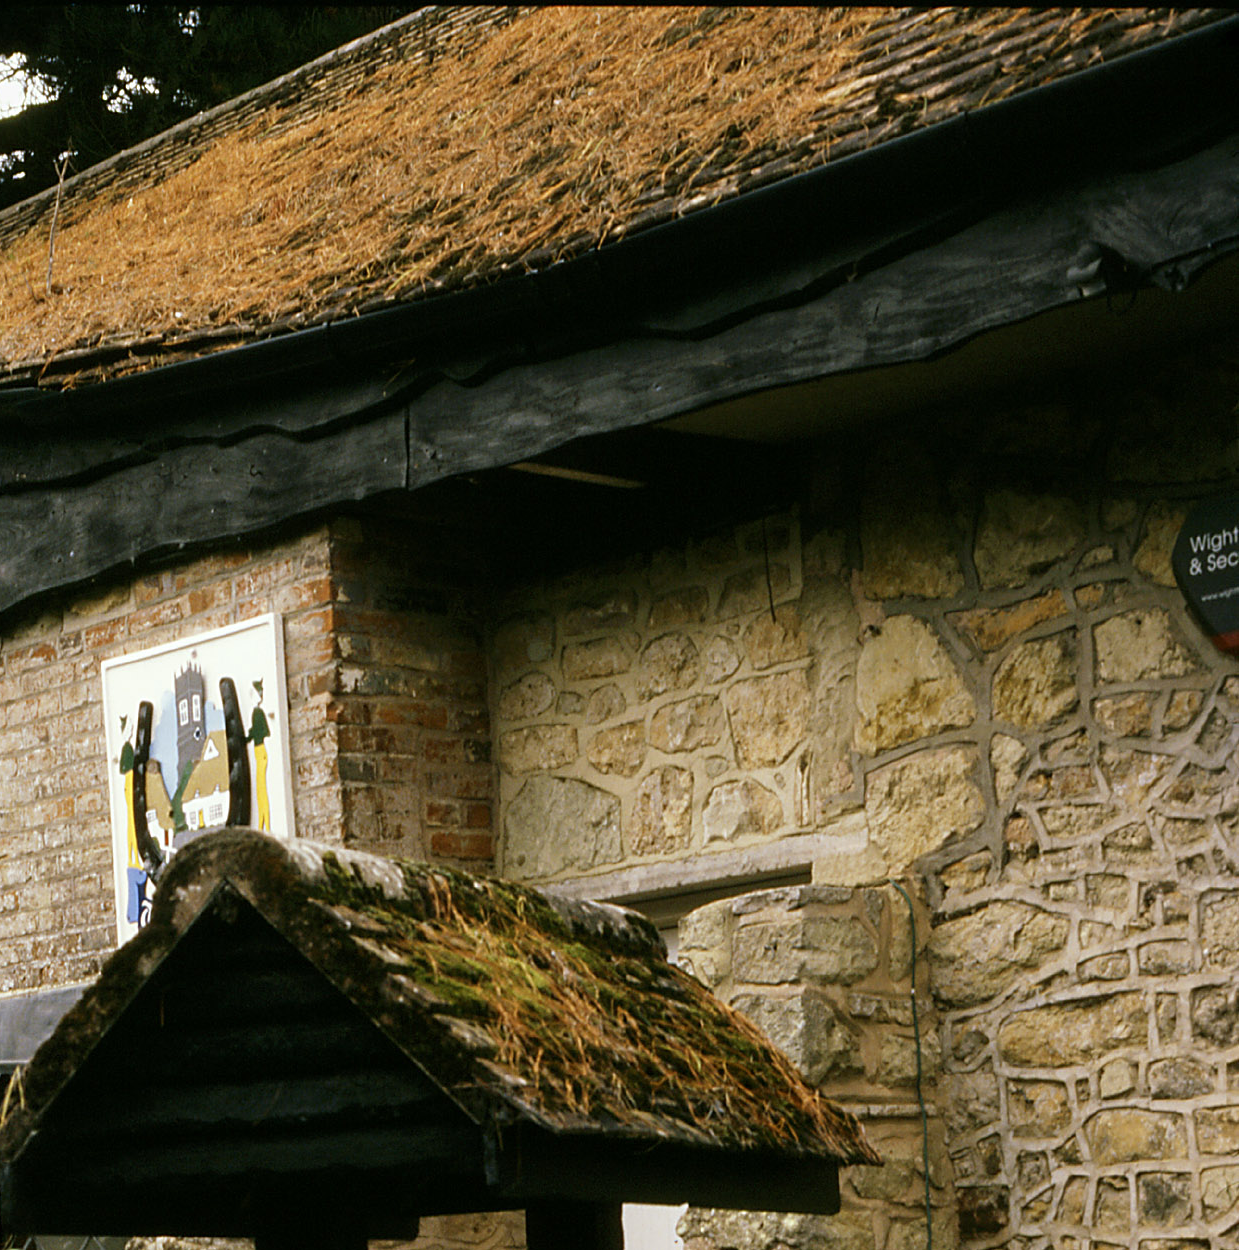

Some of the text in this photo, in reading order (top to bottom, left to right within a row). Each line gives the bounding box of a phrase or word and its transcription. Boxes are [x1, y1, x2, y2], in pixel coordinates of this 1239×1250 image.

[1189, 526, 1239, 553] Wight
[1189, 551, 1239, 576] & Sec
